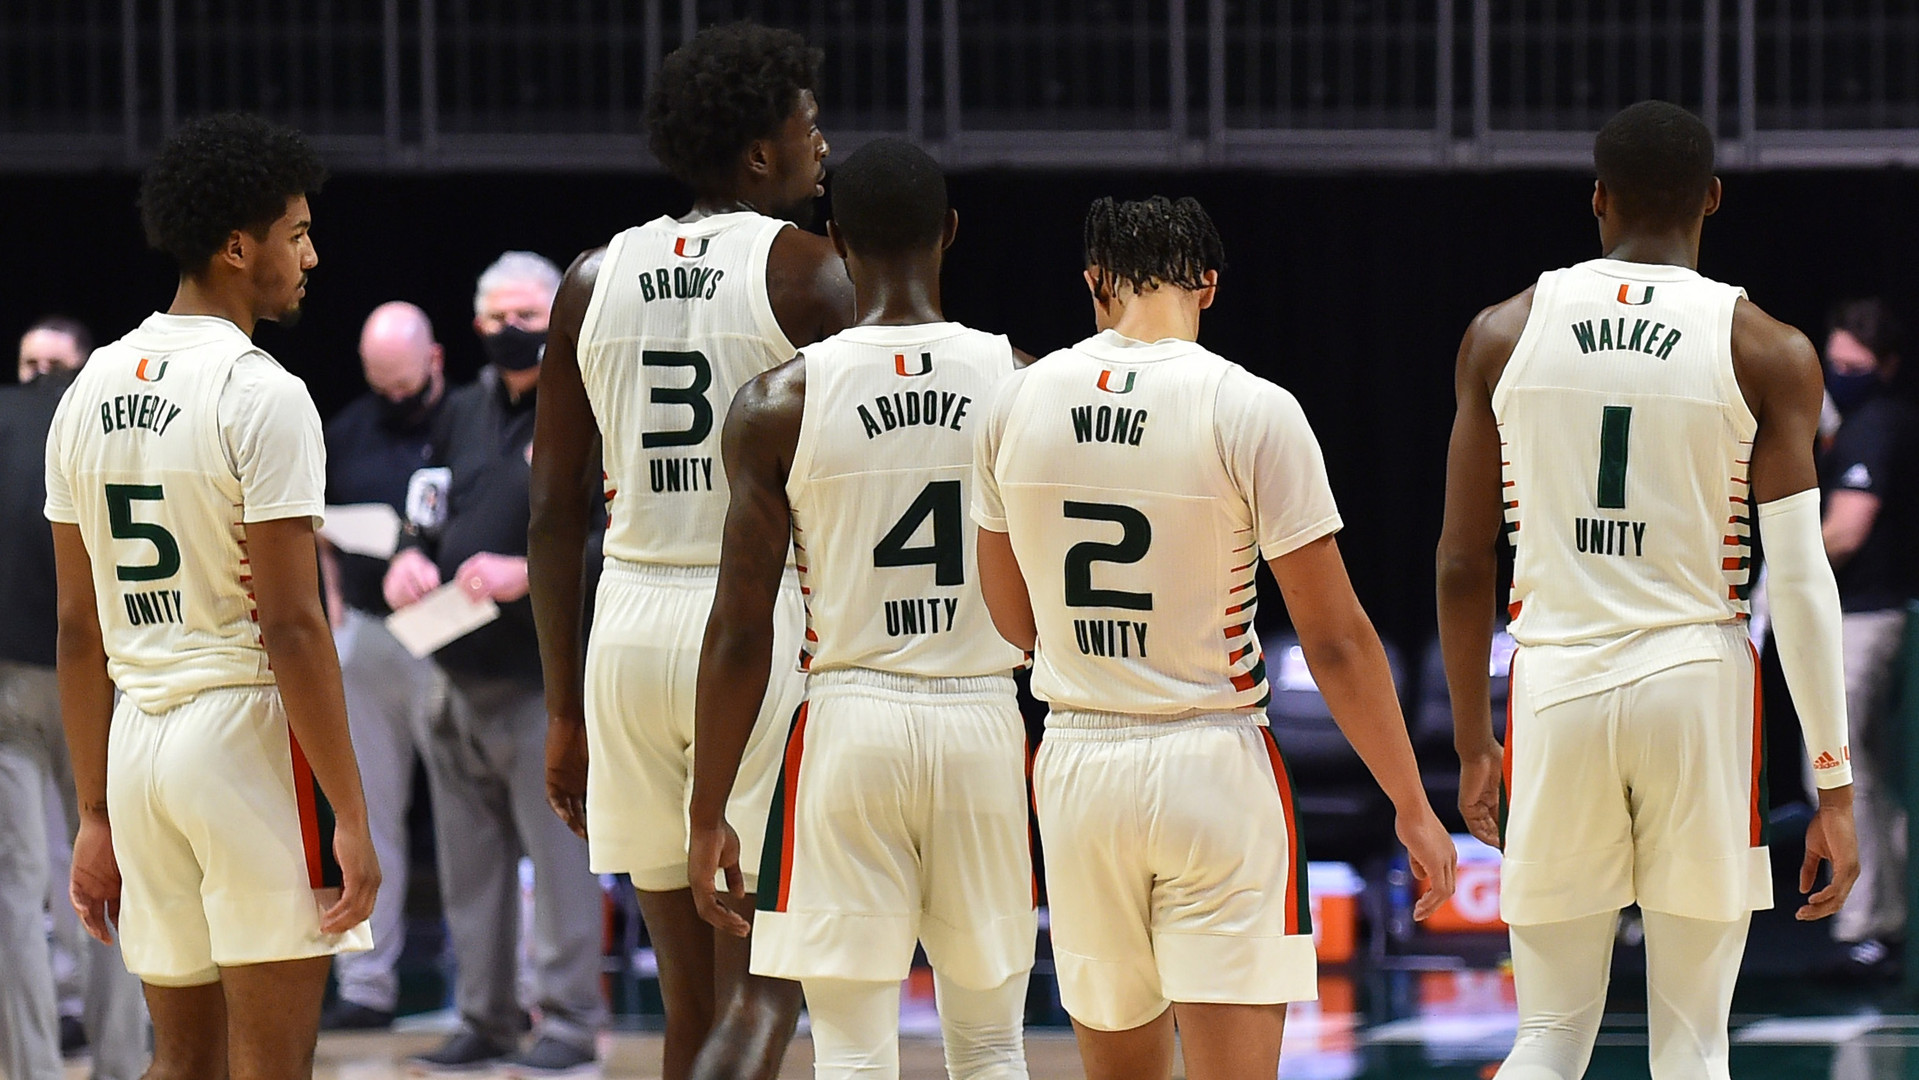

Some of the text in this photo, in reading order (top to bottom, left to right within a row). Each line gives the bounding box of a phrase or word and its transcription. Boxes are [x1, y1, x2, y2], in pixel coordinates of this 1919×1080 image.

[674, 237, 709, 258] U
[638, 266, 724, 303] BROOKS
[1617, 284, 1655, 305] U
[1571, 318, 1682, 361] WALKER
[136, 358, 168, 382] U
[895, 353, 932, 376] U
[1097, 370, 1136, 394] U
[101, 394, 181, 437] BEVERLY
[641, 350, 713, 449] 3
[856, 390, 972, 439] ABIDOYE
[1070, 405, 1148, 447] WONG
[649, 458, 713, 493] UNITY
[1596, 406, 1633, 509] 1
[105, 484, 181, 581] 5
[873, 480, 965, 586] 4
[1575, 518, 1647, 557] UNITY
[1063, 500, 1153, 611] 2
[123, 589, 184, 627] UNITY
[885, 598, 958, 637] UNITY
[1074, 619, 1148, 658] UNITY
